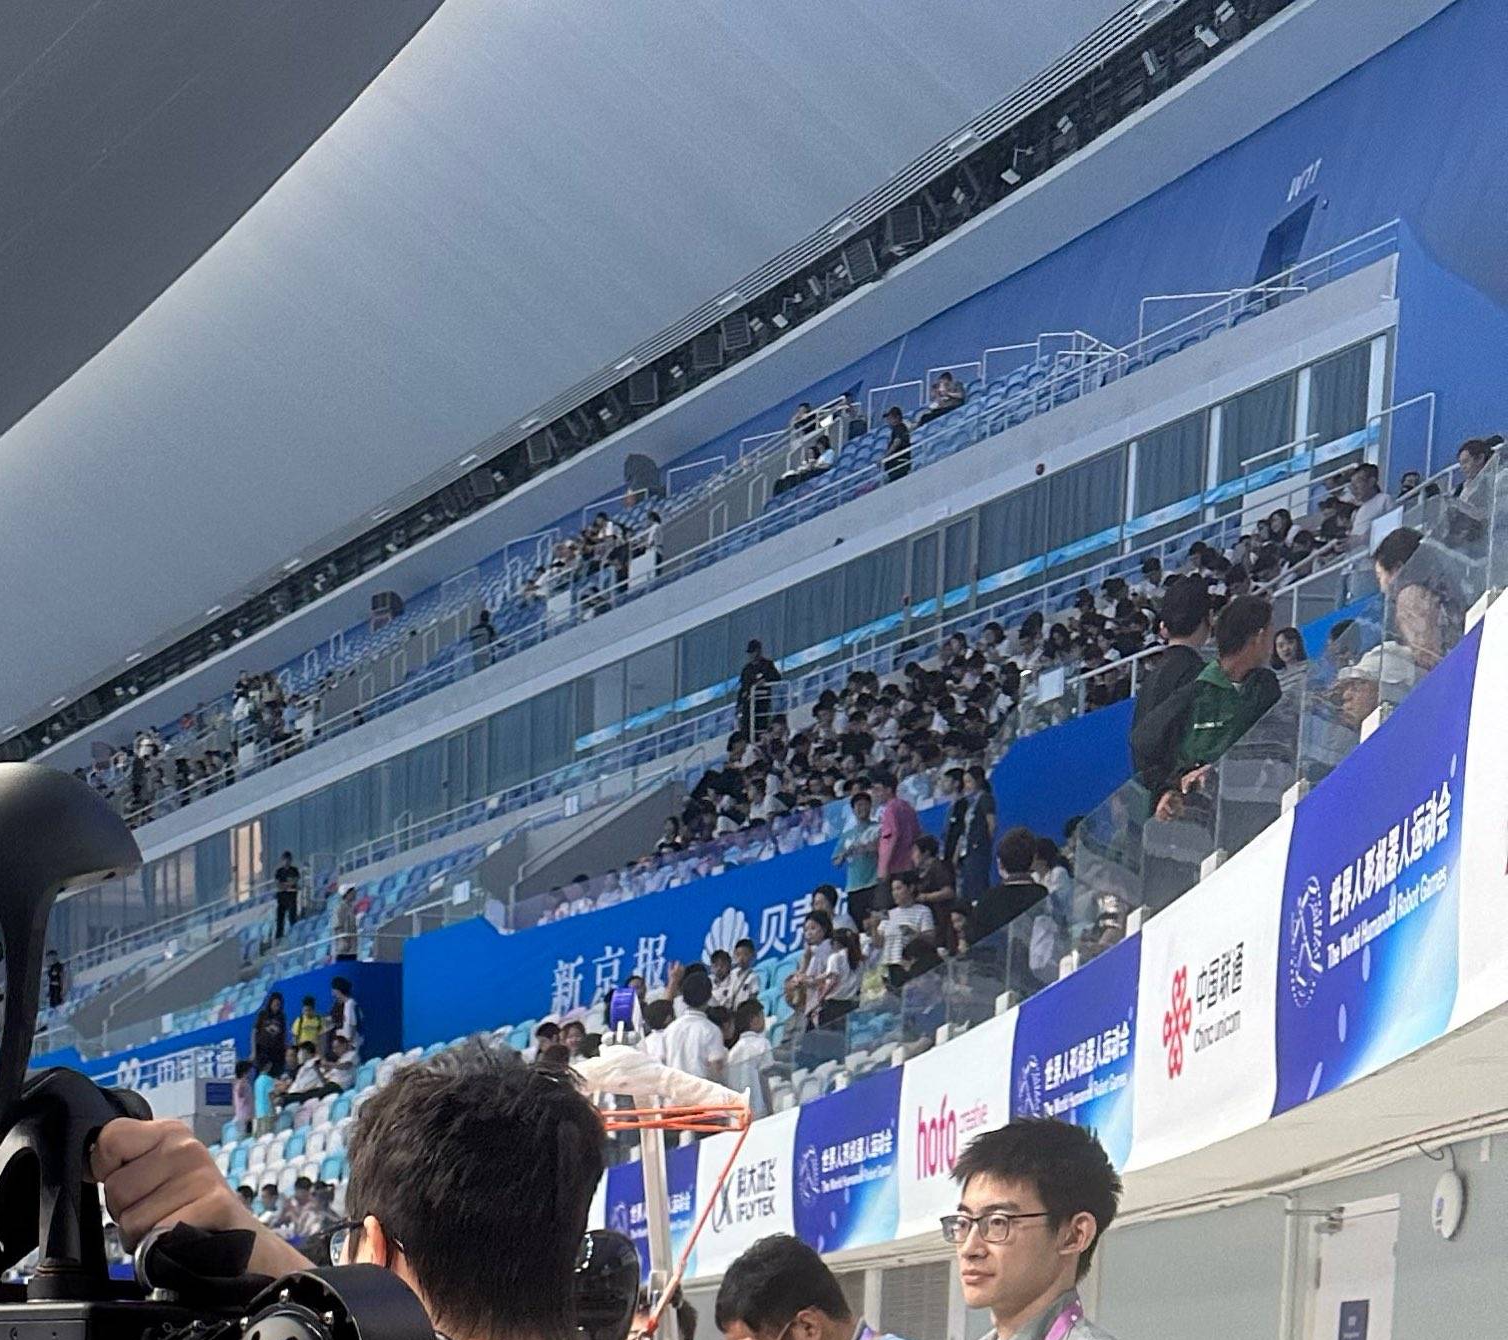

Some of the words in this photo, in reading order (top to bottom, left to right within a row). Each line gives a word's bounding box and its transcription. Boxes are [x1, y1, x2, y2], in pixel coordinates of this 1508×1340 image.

[1329, 781, 1451, 926] 世界人形机器人运动会
[1327, 943, 1340, 969] The
[1341, 923, 1361, 961] World
[1397, 883, 1419, 920] Robot
[1420, 865, 1448, 903] Games
[551, 934, 668, 1017] 新京报
[1196, 941, 1244, 1014] 中国联通
[1044, 1020, 1130, 1091] 世界人形机器人运动会
[821, 1128, 893, 1173] 世界人形机器人运动会
[917, 1093, 956, 1181] hofo
[738, 1157, 777, 1198] 科大讯飞
